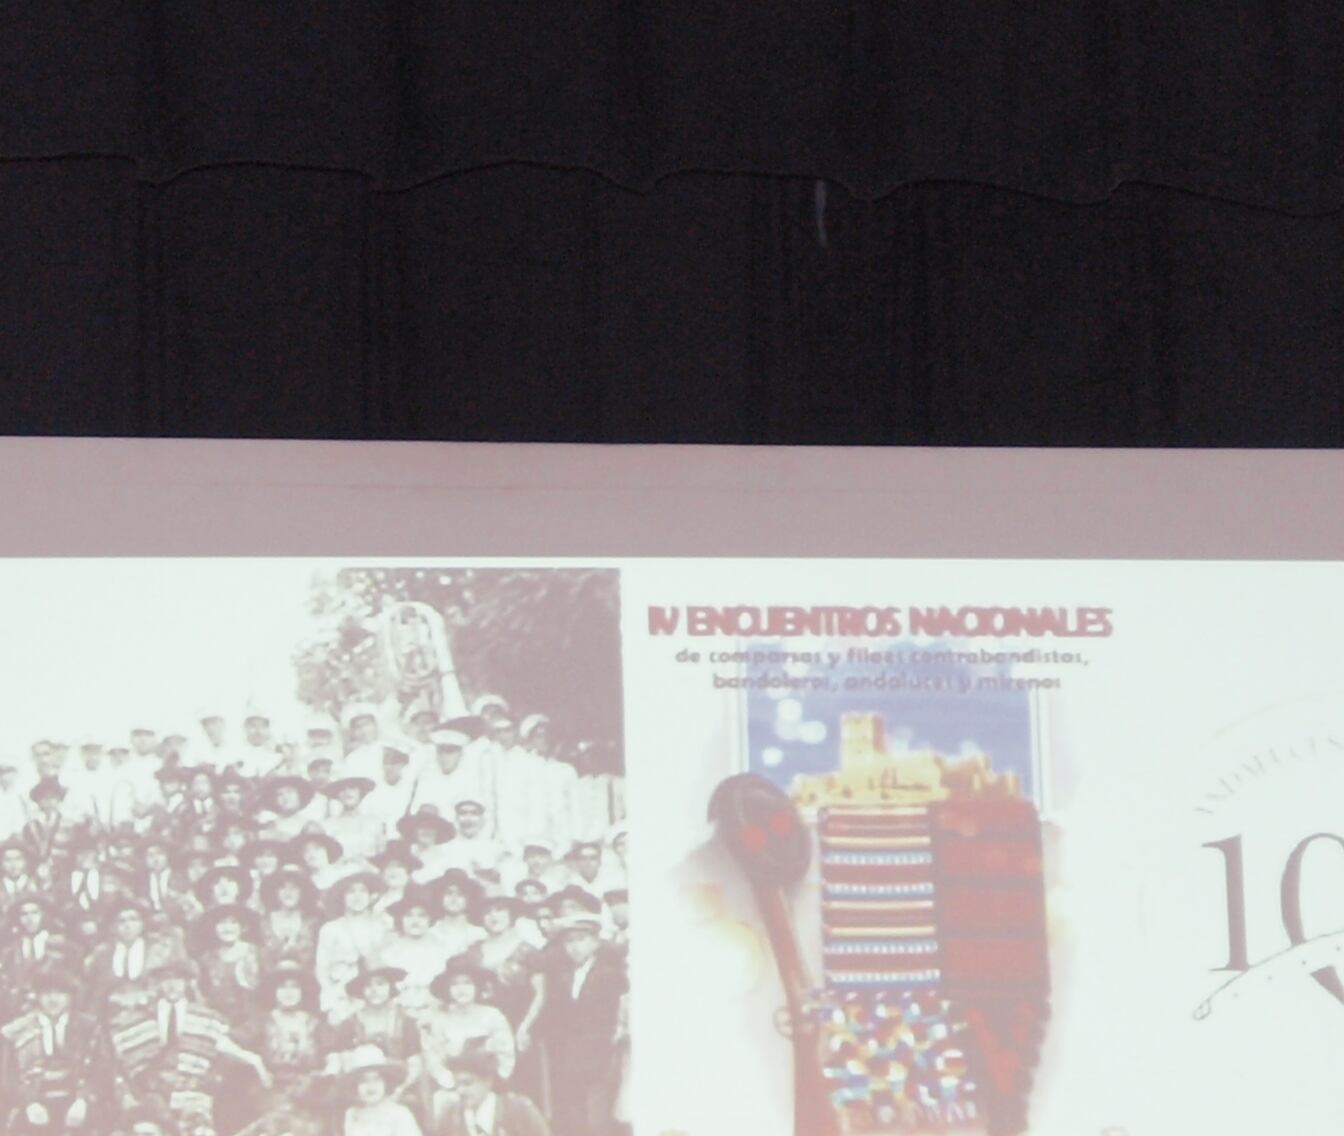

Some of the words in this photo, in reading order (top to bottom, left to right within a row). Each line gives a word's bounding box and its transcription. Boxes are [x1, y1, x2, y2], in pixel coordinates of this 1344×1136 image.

[647, 605, 680, 636] IV
[686, 605, 903, 637] ENCUENTROS
[908, 605, 1115, 637] NACIONALES
[674, 648, 702, 665] de
[708, 650, 822, 668] comparsas
[827, 651, 841, 668] y
[910, 648, 1090, 667] contrabandistas,
[712, 672, 839, 692] bandoleros,
[844, 672, 953, 690] andaluces
[956, 674, 971, 692] y
